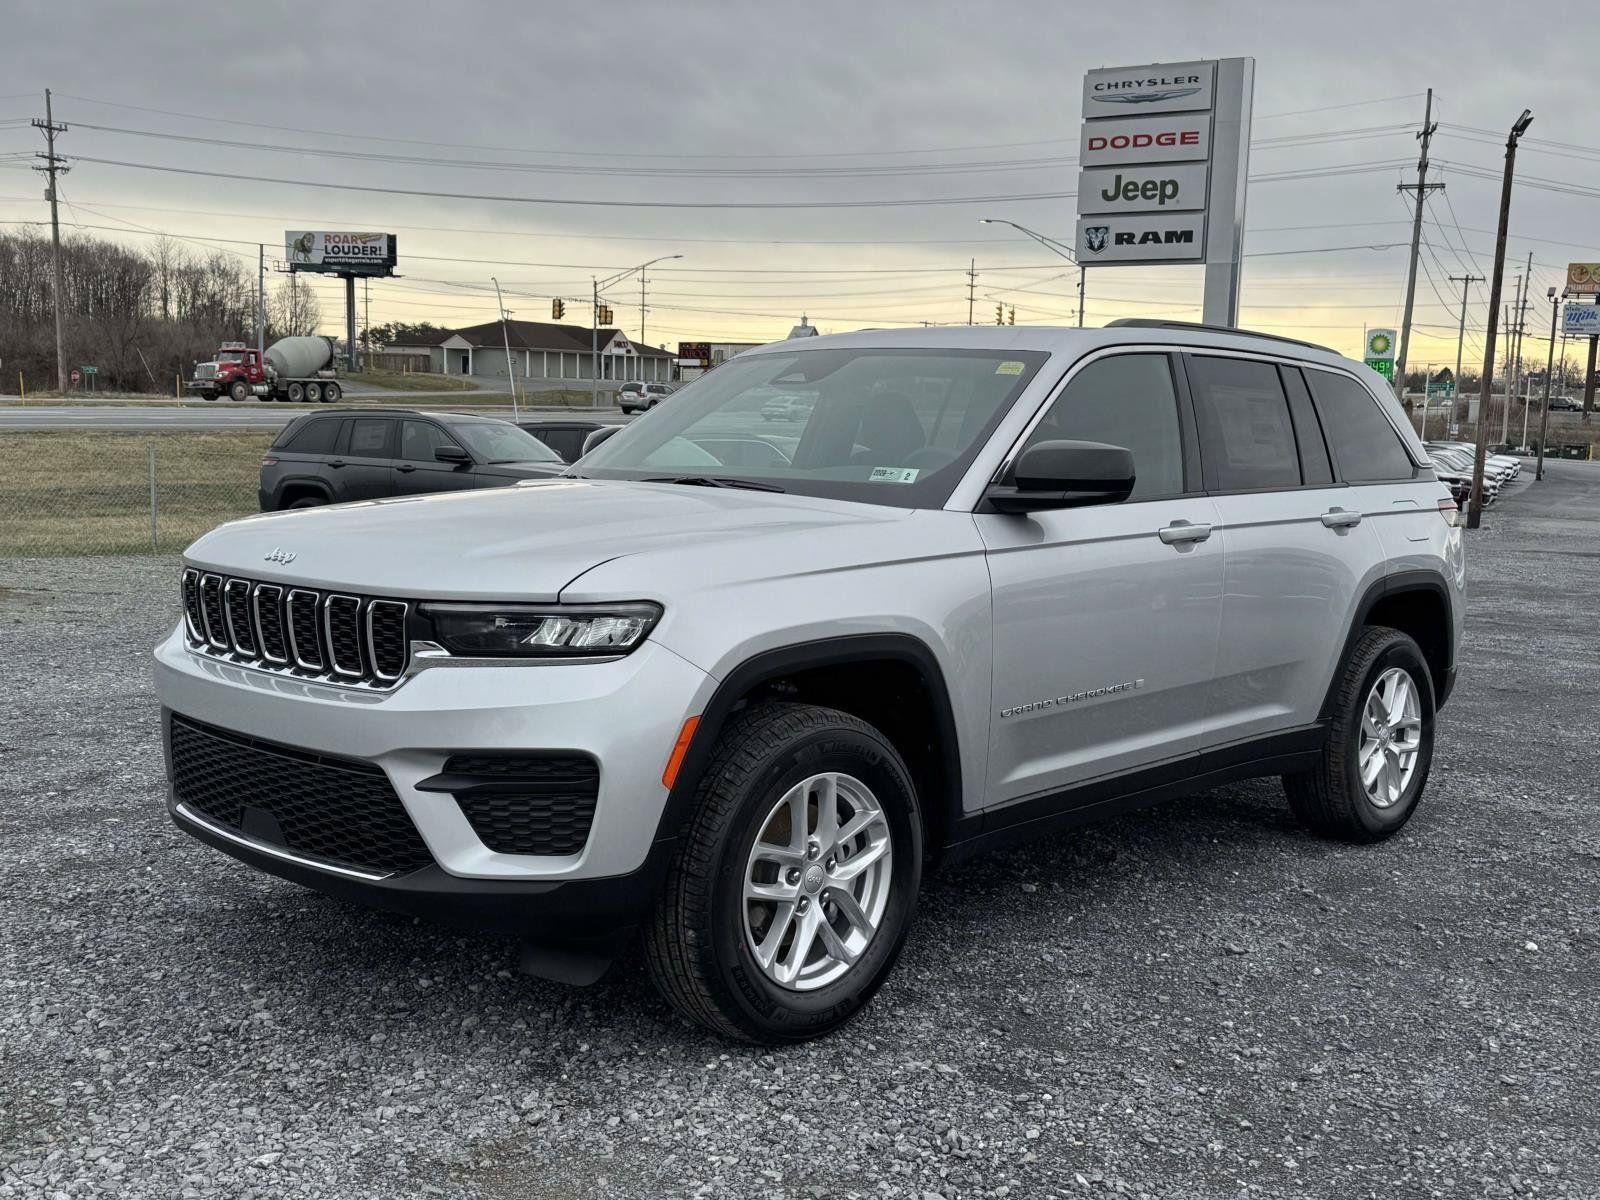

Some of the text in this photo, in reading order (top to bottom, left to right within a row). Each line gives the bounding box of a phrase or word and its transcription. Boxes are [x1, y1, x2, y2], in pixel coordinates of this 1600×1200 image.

[1094, 75, 1200, 91] CHRYSLER
[1088, 131, 1200, 151] DODGE
[1101, 174, 1179, 205] Jeep
[324, 234, 359, 245] ROAR
[1114, 230, 1194, 245] RAM
[324, 245, 382, 256] LOUDER!
[263, 547, 297, 567] Jeep
[1000, 682, 1132, 718] GRAND CHEROKEE
